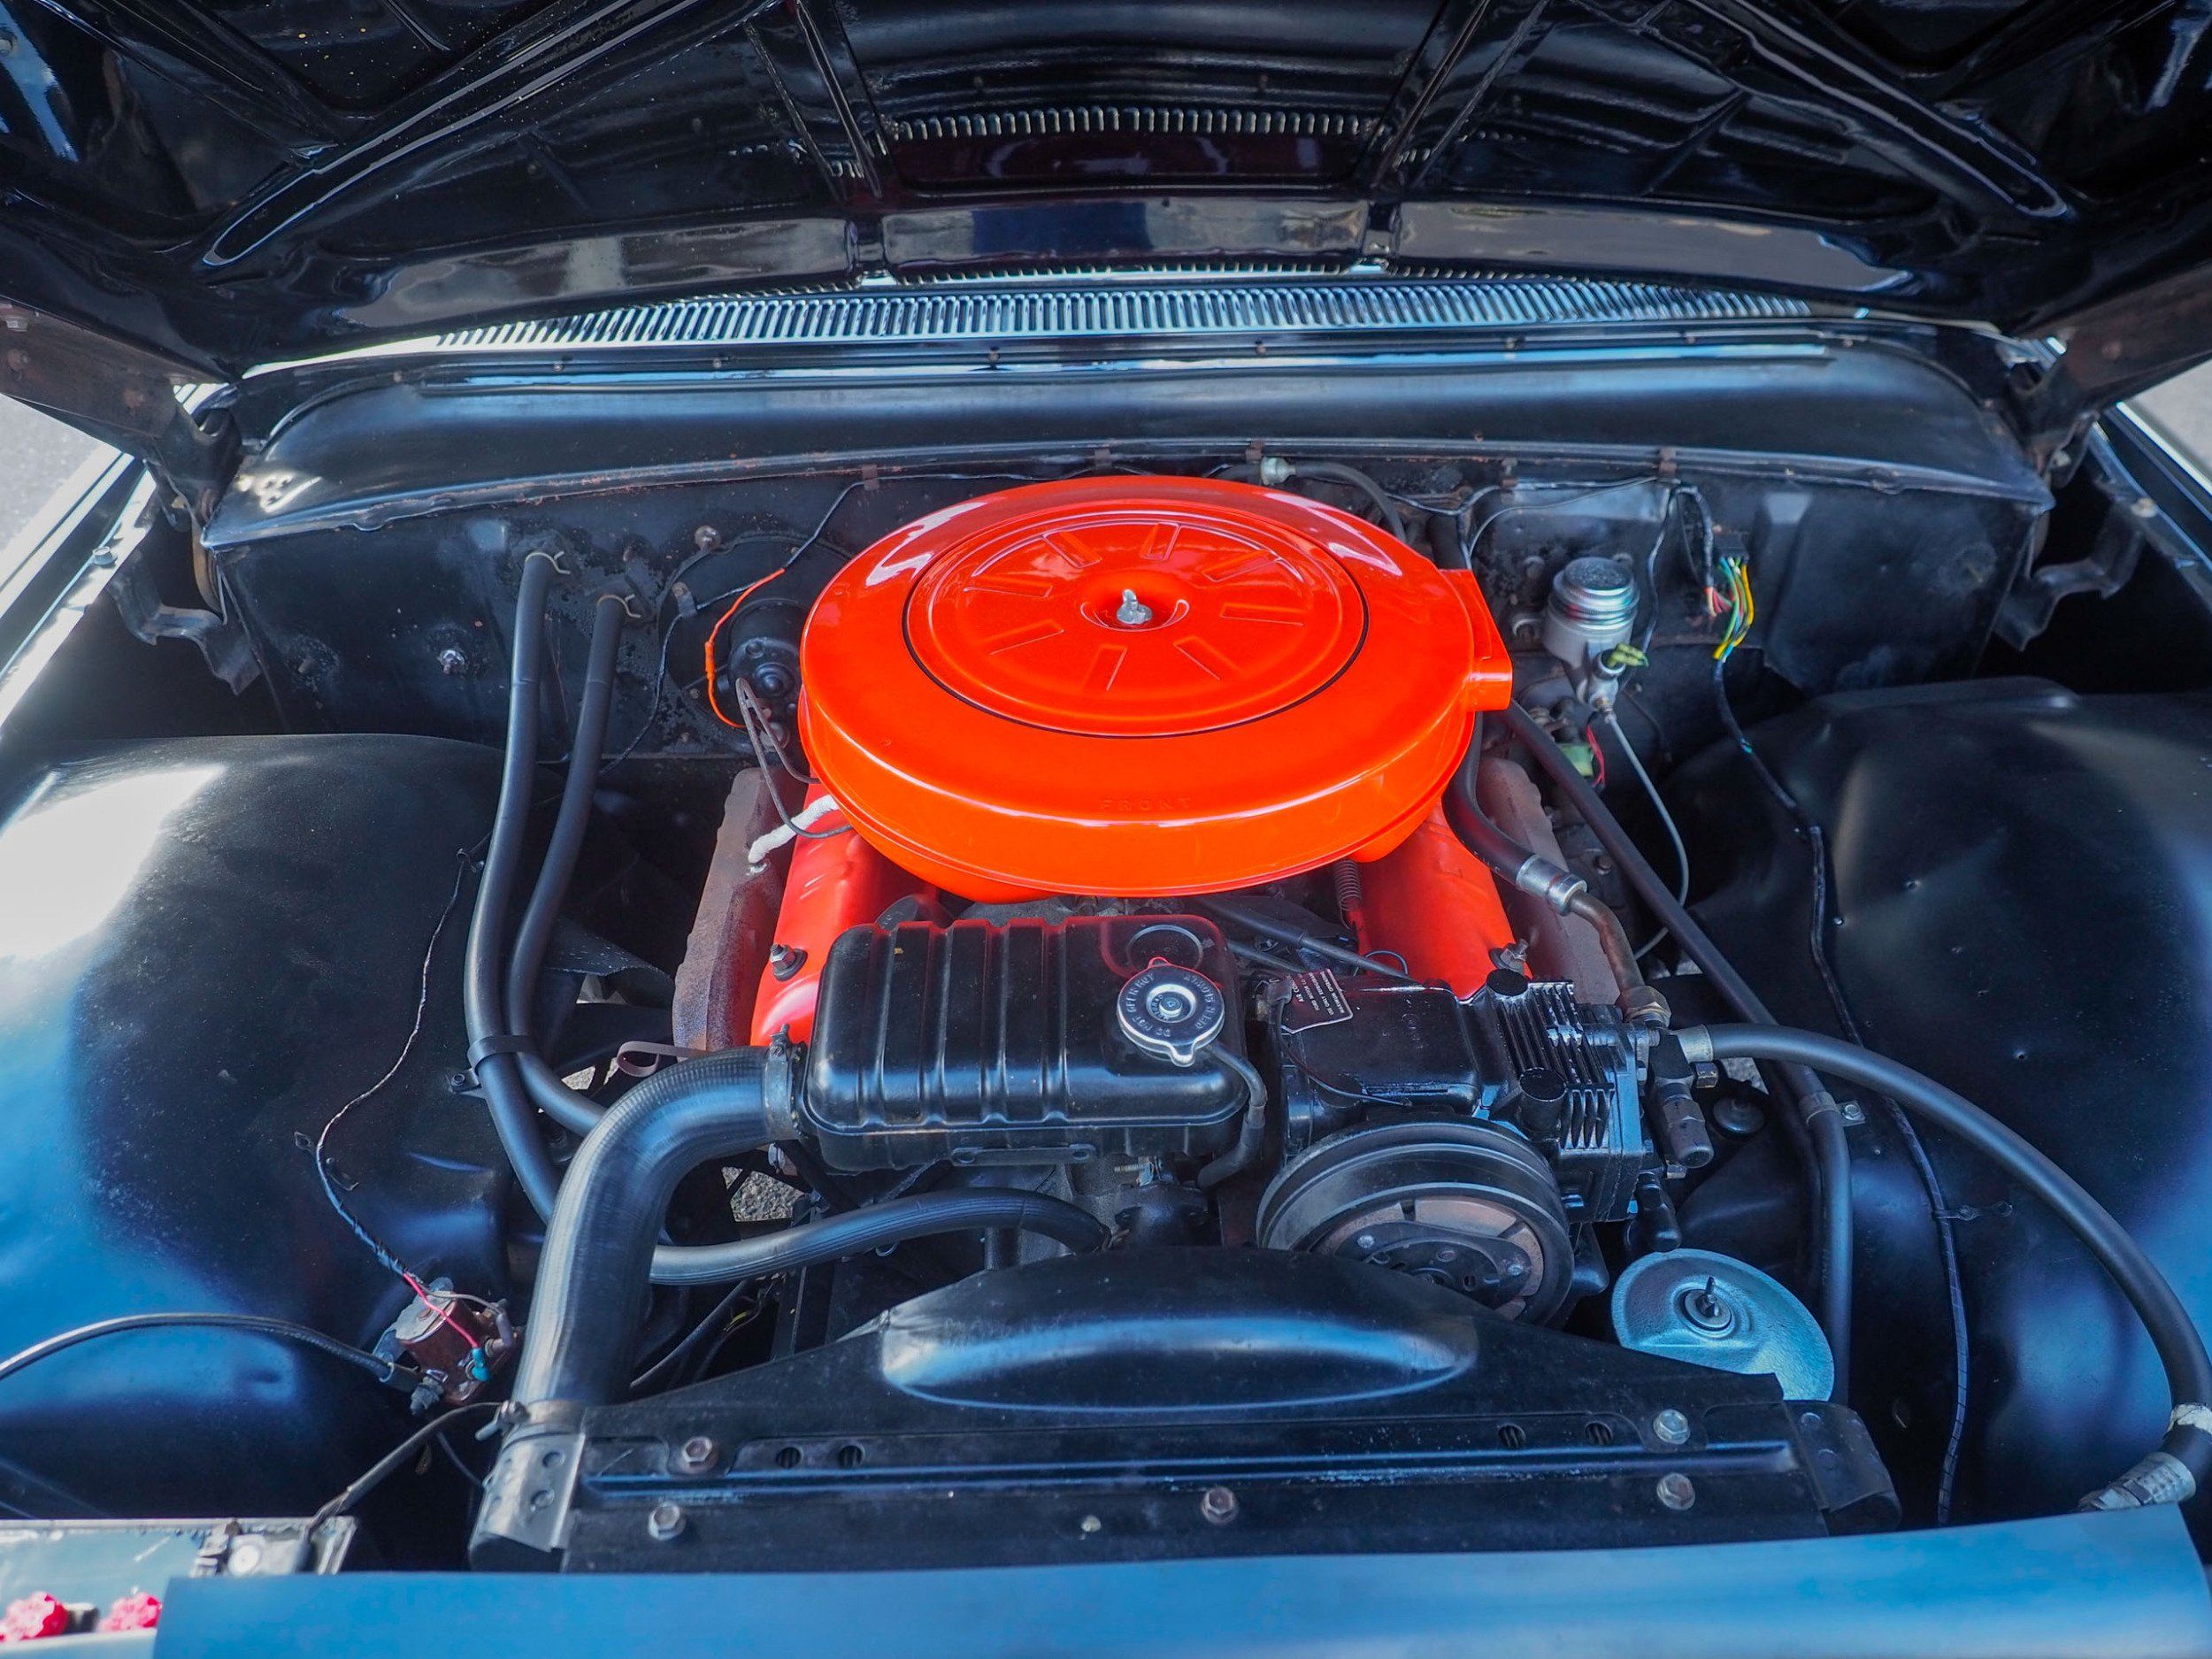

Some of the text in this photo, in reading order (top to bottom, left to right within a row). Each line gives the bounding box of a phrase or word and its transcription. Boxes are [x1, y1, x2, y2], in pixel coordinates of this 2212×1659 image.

[1100, 796, 1190, 812] FRONT
[1295, 993, 1305, 1002] AIR
[1304, 986, 1314, 1000] MOTOR
[1311, 1000, 1321, 1010] FORD
[1321, 996, 1330, 1007] ONLY
[1331, 993, 1345, 1013] MAXIMUM
[1132, 1017, 1153, 1031] NOT
[1156, 1028, 1171, 1037] DO
